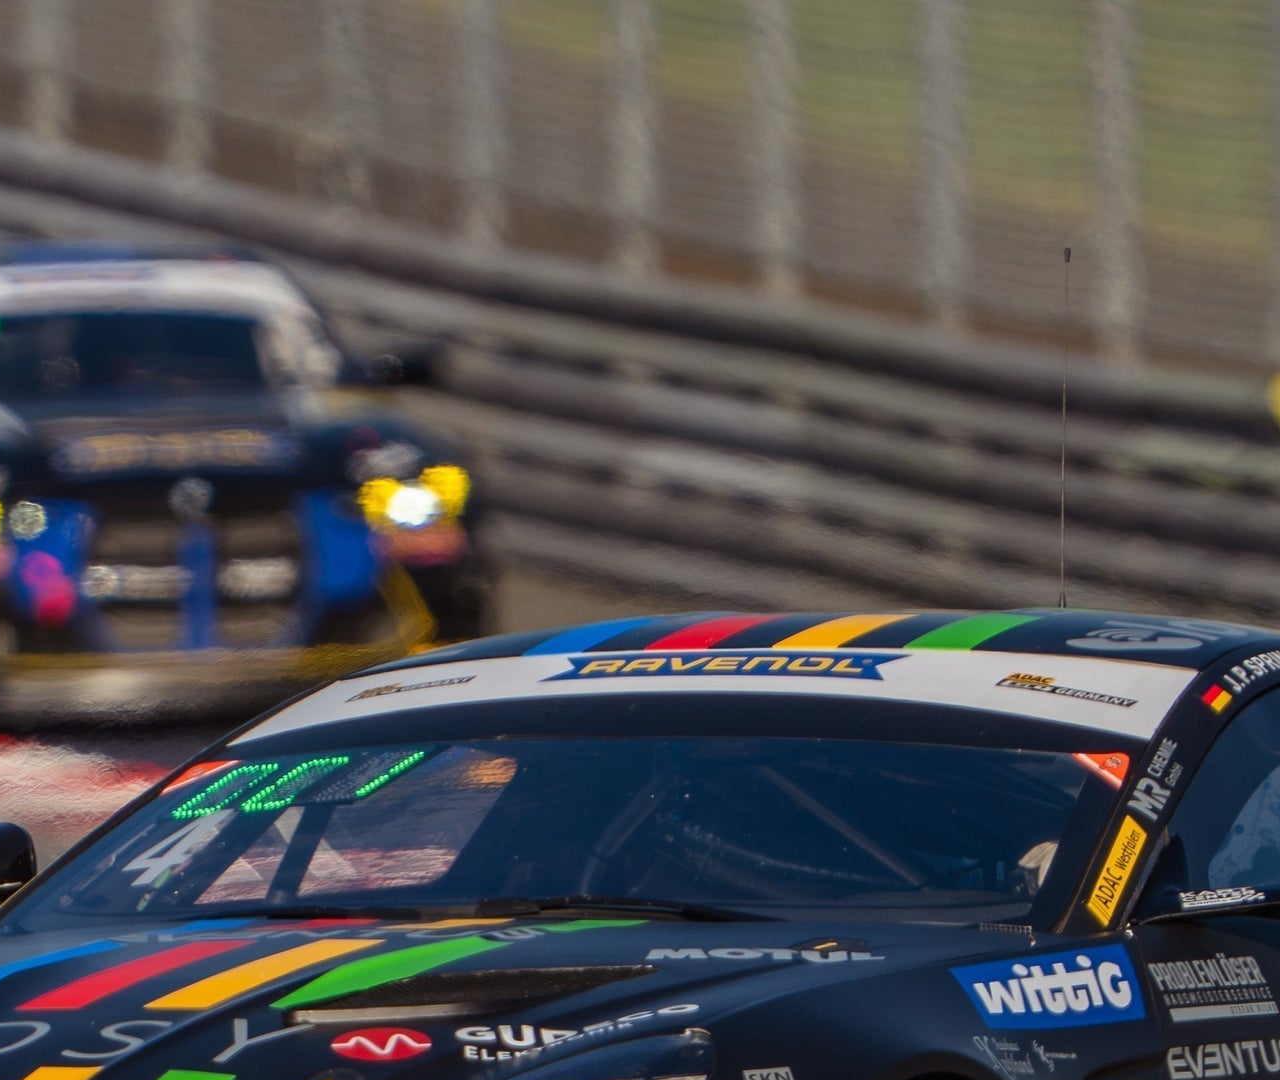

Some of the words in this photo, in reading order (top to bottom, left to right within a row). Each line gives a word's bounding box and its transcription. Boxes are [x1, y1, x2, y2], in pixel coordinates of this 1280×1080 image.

[578, 655, 863, 674] RAVENOL
[1010, 673, 1054, 684] ADAC
[1055, 686, 1136, 706] GERMANY
[1127, 777, 1172, 822] MR
[121, 808, 238, 886] 4
[1094, 867, 1123, 909] ADAC
[1114, 829, 1142, 871] Westfalen
[646, 946, 886, 964] MOTUL
[1148, 953, 1268, 991] PROBLEMLÖSER
